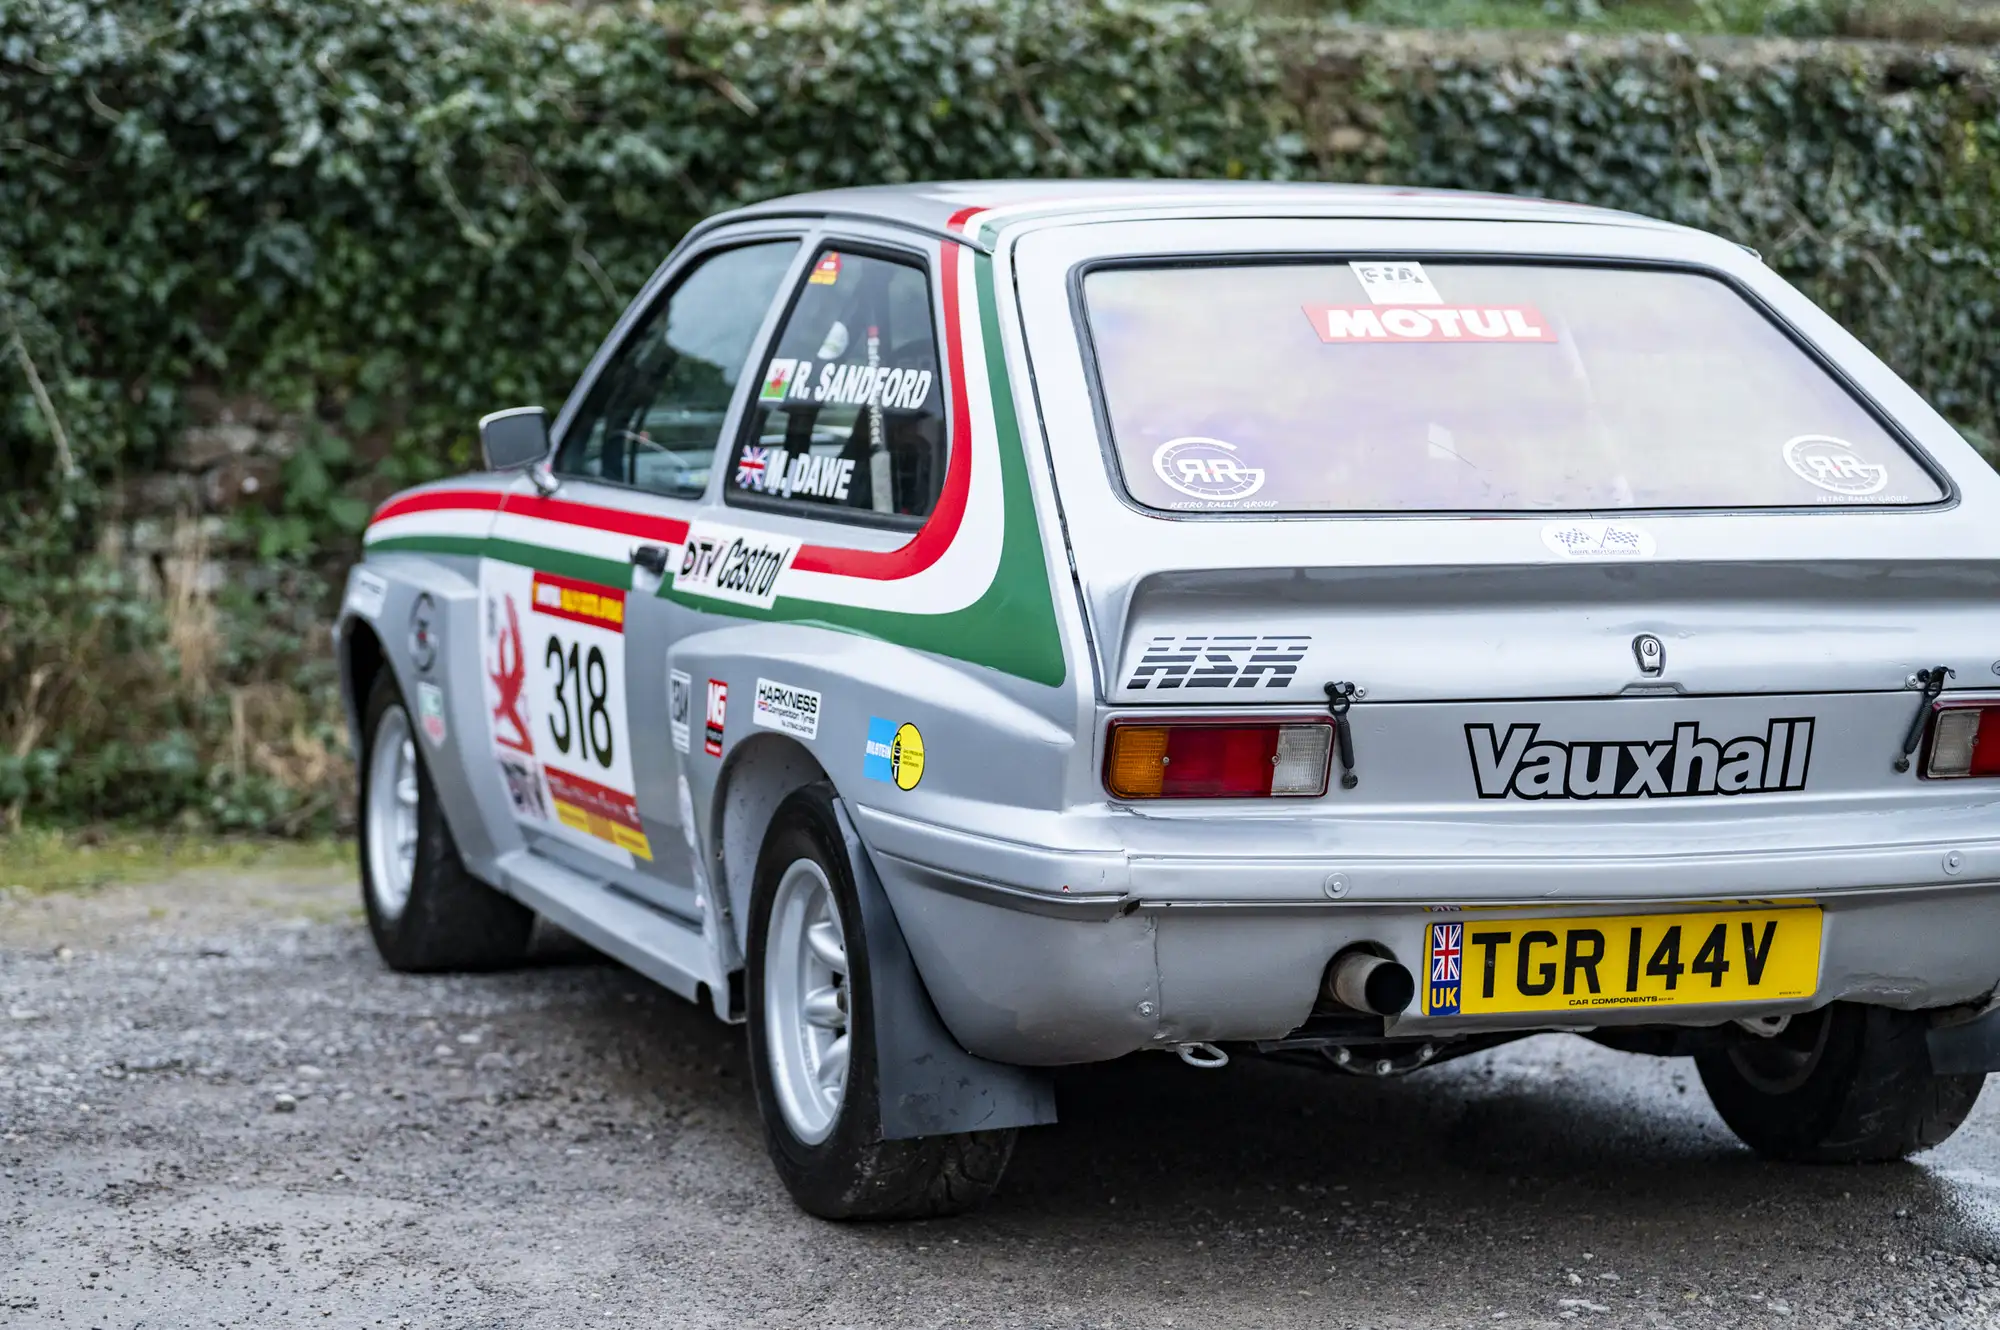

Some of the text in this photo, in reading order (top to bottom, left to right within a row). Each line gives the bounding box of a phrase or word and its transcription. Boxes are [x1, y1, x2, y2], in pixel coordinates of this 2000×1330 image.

[1327, 308, 1543, 338] MOTUL
[788, 360, 933, 410] R. SANDFORD
[791, 452, 856, 500] DAWE
[1816, 495, 1910, 503] RETRO RALLY GROUP
[1169, 499, 1280, 510] RETRO RALLY GROUP
[716, 536, 791, 597] Castrol
[1126, 636, 1313, 690] HSR
[546, 634, 613, 769] 318
[758, 683, 818, 714] HARKNESS
[1463, 716, 1816, 800] Vauxhall
[1471, 920, 1778, 999] TGR 144V
[1431, 986, 1459, 1009] UK
[1591, 996, 1658, 1005] COMPONENTS
